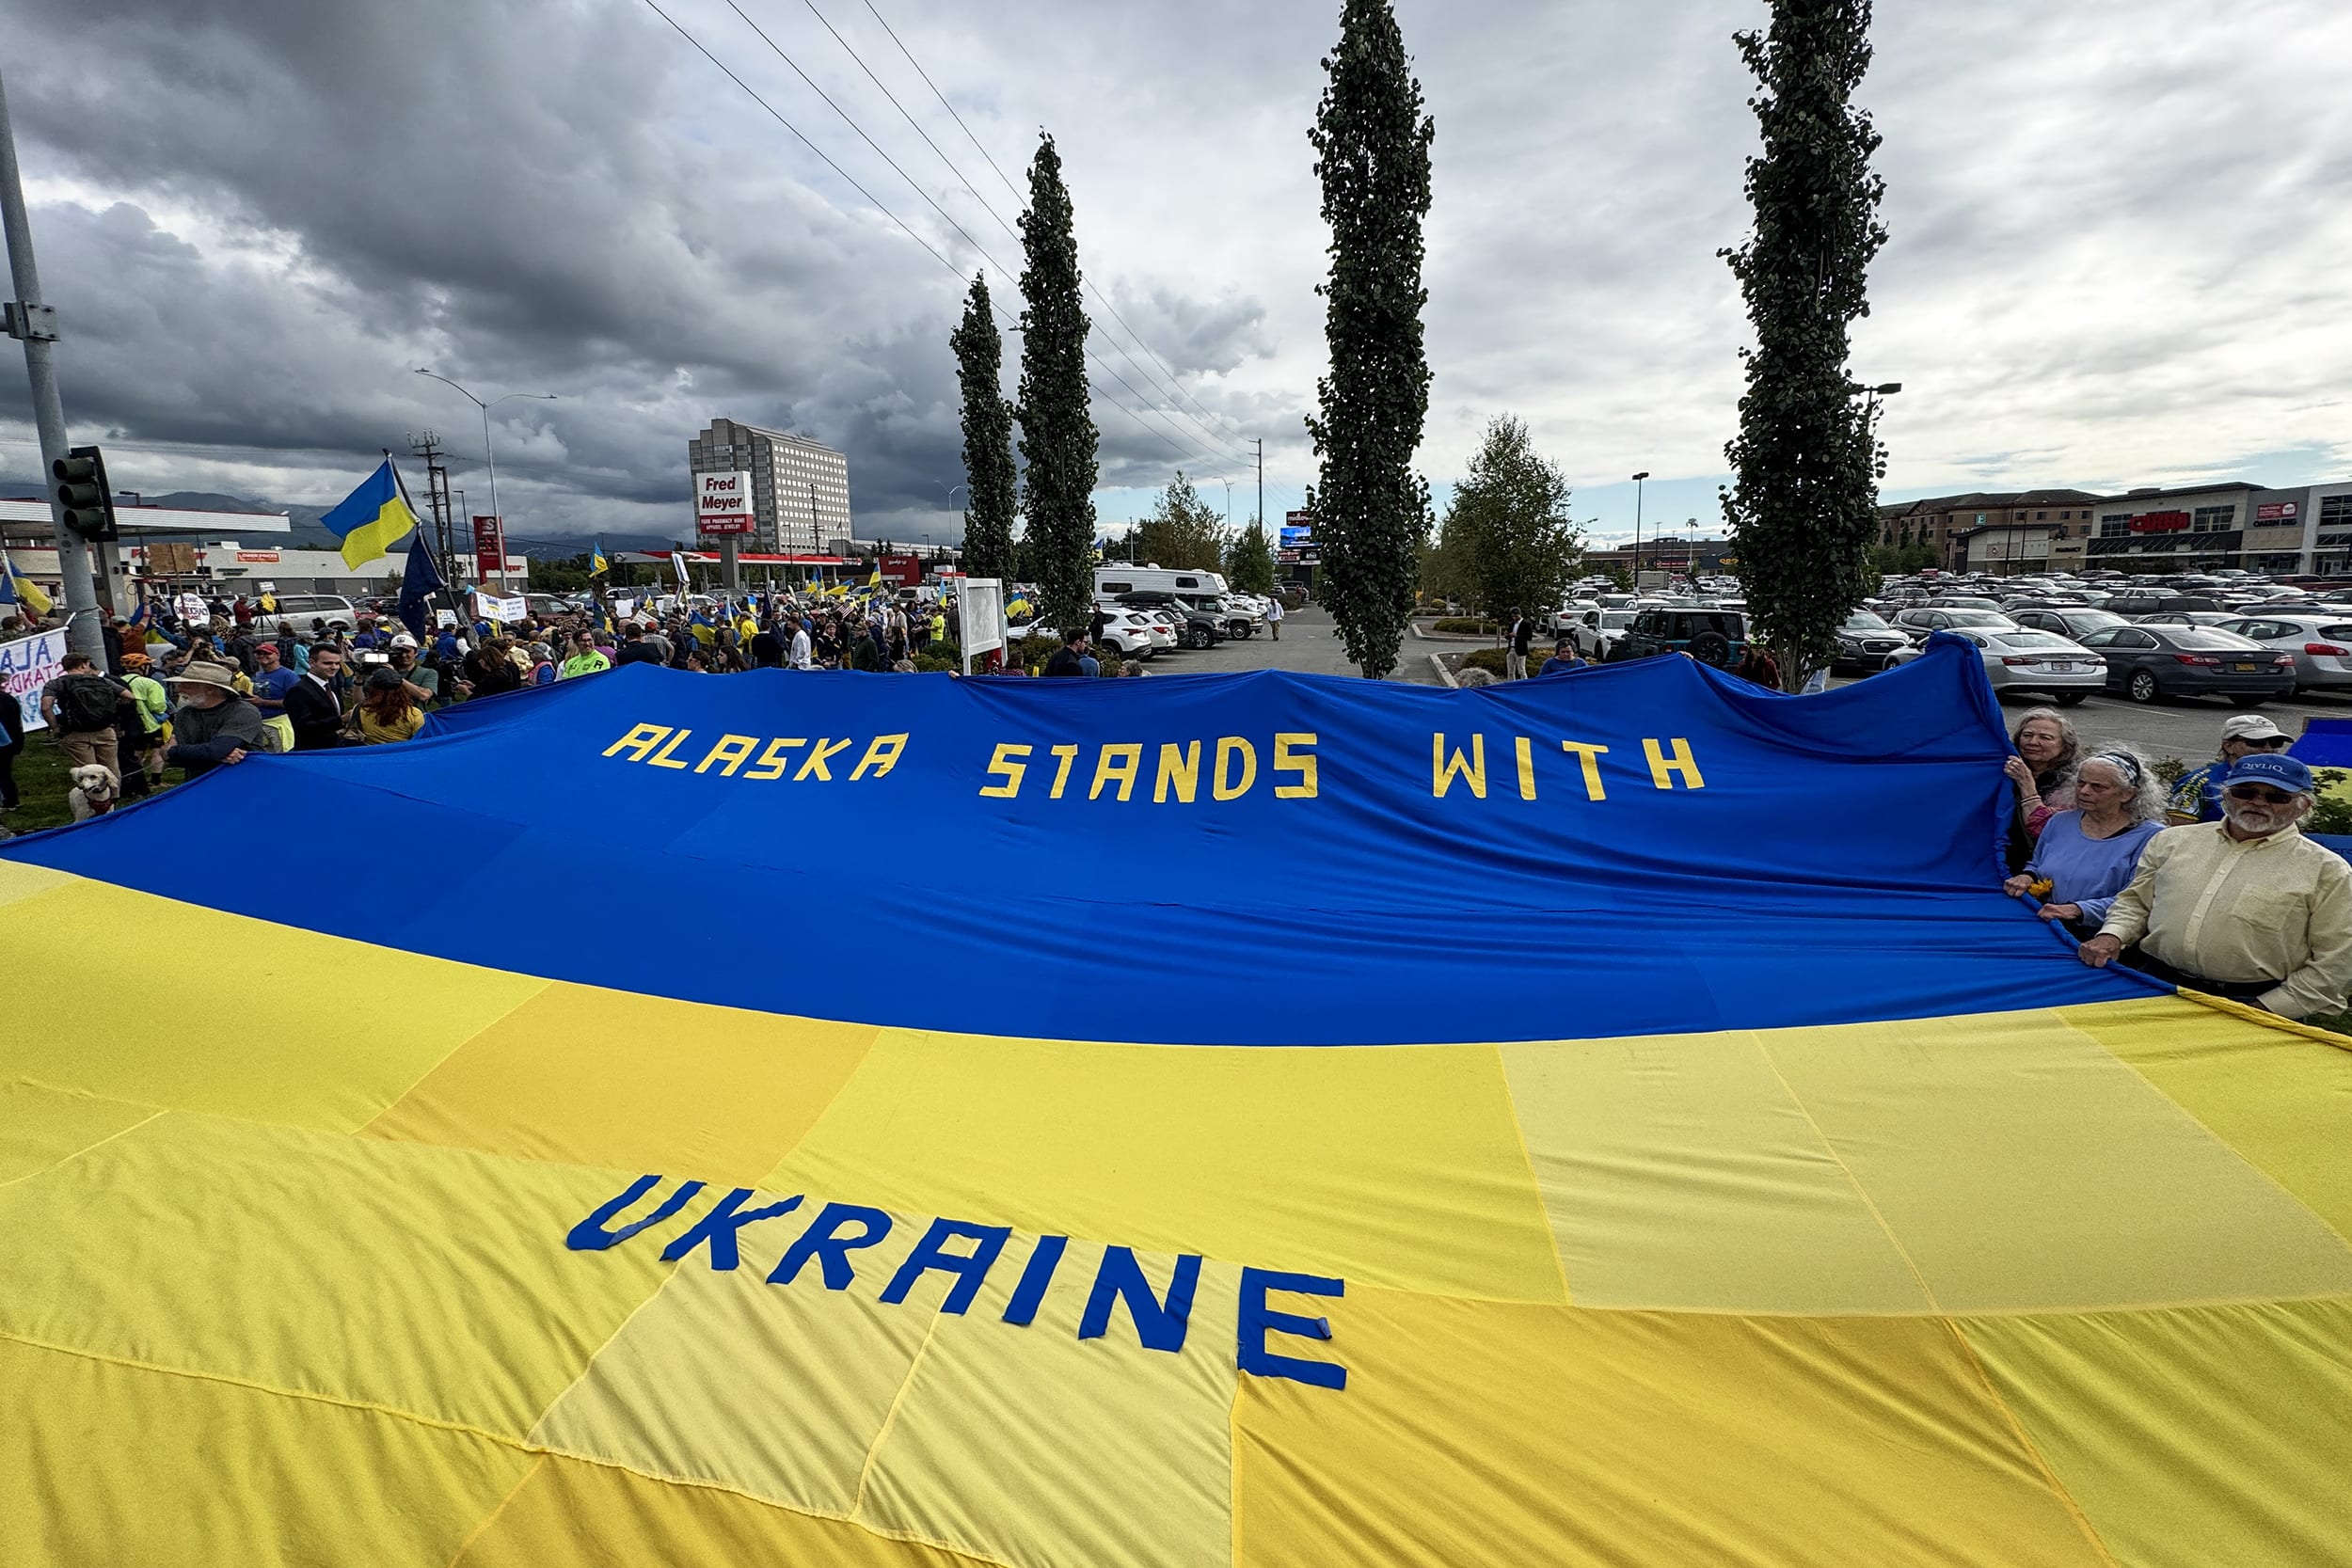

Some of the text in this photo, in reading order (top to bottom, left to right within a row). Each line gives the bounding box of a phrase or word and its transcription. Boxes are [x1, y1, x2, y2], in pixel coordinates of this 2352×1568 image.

[706, 477, 736, 490] Fred
[702, 496, 742, 511] Meyer
[601, 722, 1705, 802] ALASKA STANDS WITH
[2242, 763, 2288, 775] QIVLIQ
[566, 1174, 1347, 1390] UKRAINE
